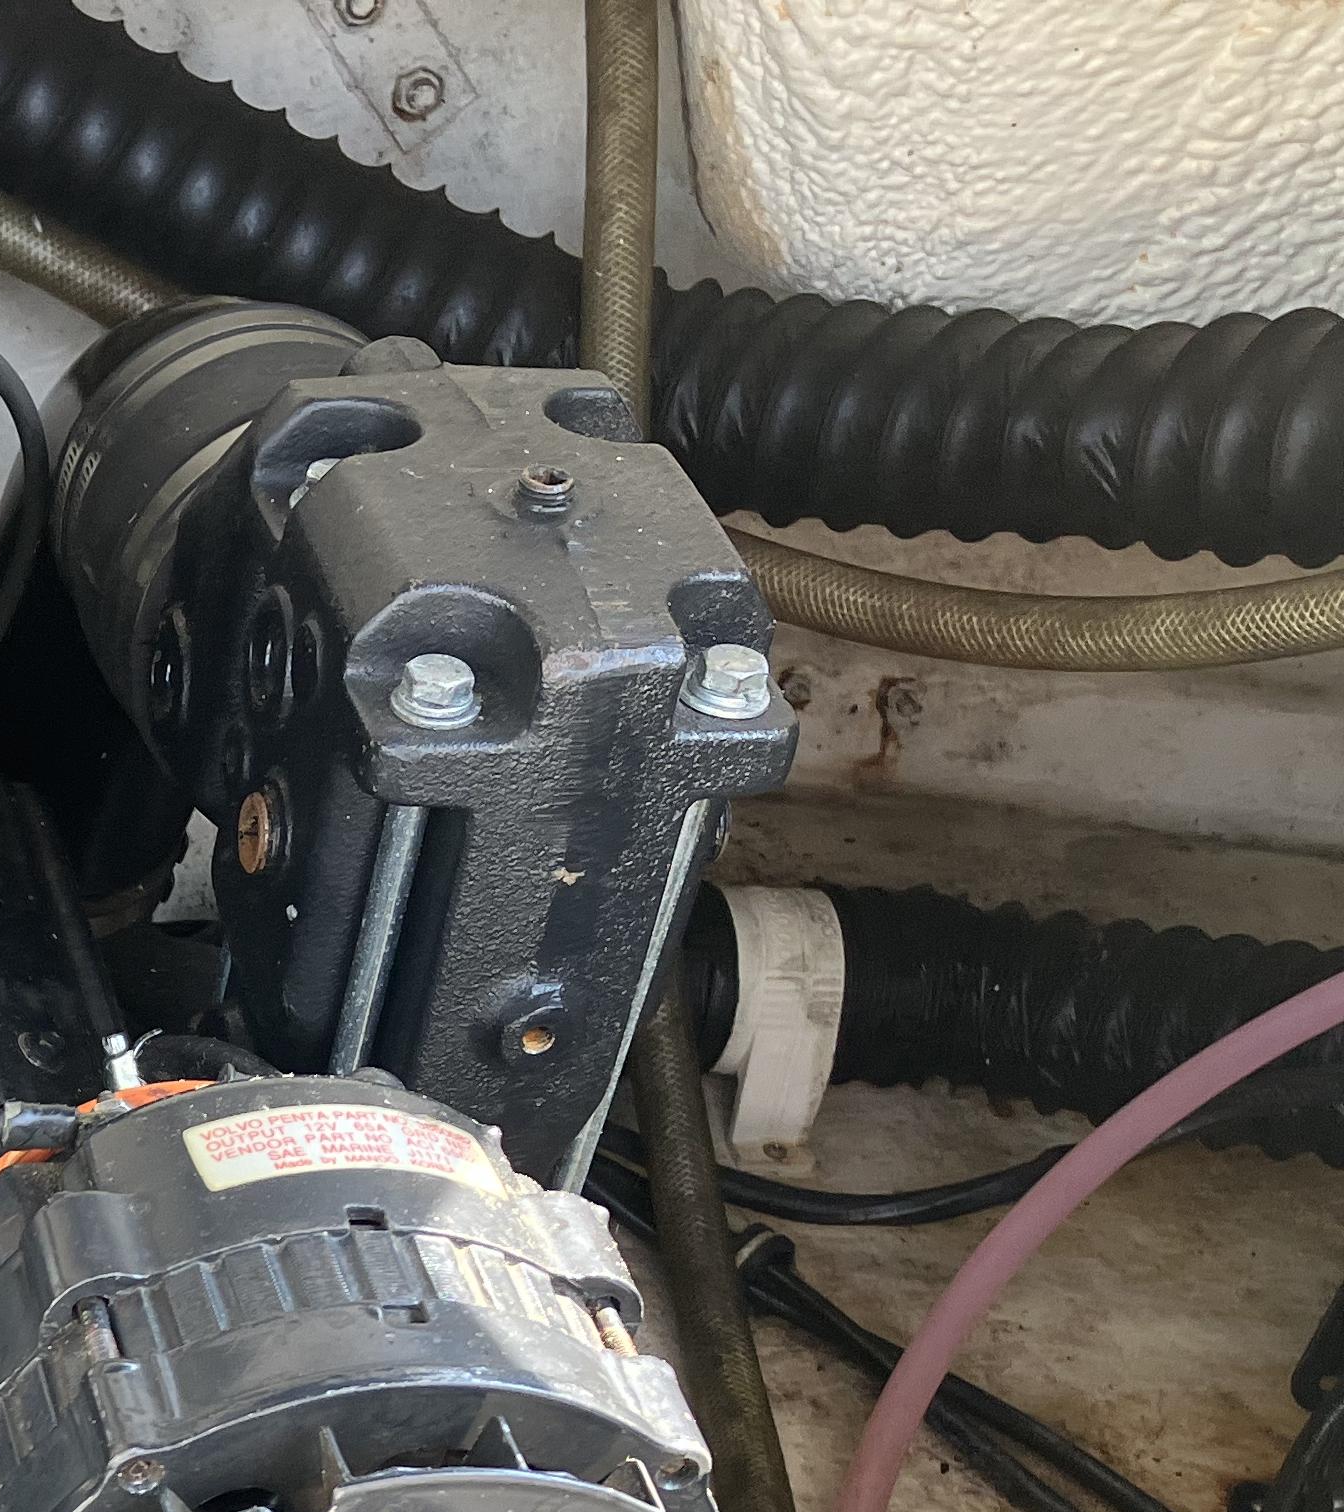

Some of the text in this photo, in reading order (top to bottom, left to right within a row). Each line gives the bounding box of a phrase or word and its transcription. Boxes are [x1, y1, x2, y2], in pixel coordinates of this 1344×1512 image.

[199, 1118, 264, 1142] VOLVO
[267, 1111, 330, 1128] PENTA
[331, 1110, 380, 1124] PART
[205, 1125, 288, 1155] OUTPUT
[301, 1122, 338, 1135] 12V
[210, 1135, 297, 1164] VENDOR
[303, 1131, 360, 1146] PART
[364, 1132, 394, 1145] NO
[266, 1145, 307, 1162] SAE
[320, 1142, 393, 1156] MARINE
[272, 1157, 314, 1172] Made
